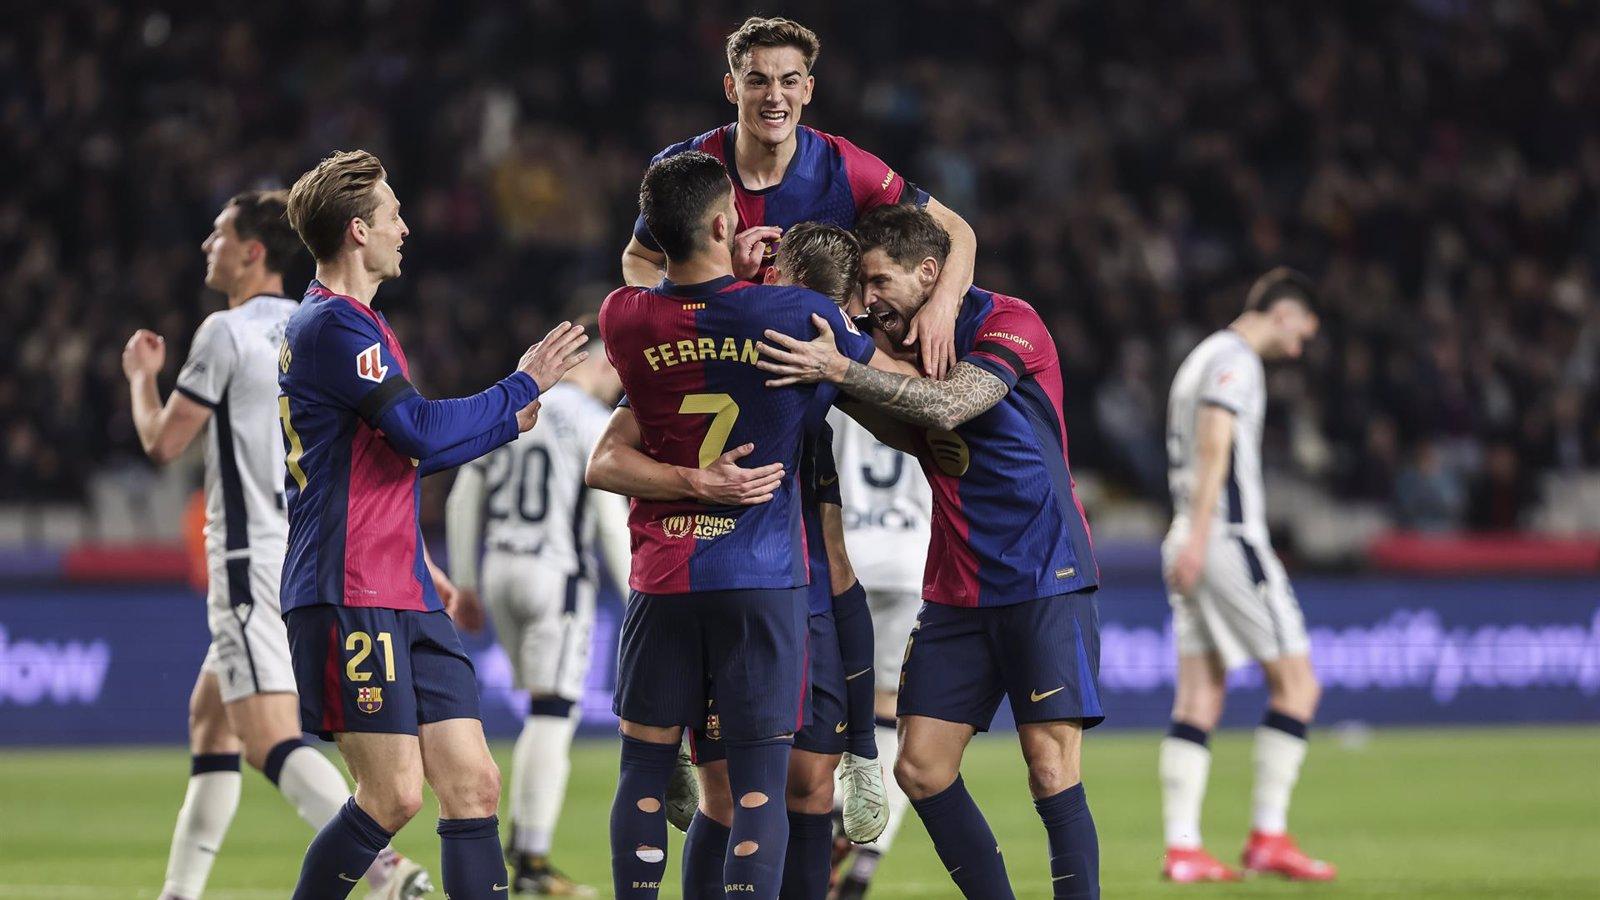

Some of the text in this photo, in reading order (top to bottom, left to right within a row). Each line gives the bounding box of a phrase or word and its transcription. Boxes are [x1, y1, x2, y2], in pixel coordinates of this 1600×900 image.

[278, 338, 293, 374] NG
[643, 337, 760, 372] FERRAN
[983, 332, 1029, 348] AMBILIGHT
[678, 393, 740, 470] 7
[486, 444, 550, 521] 20
[693, 525, 732, 537] ACN
[345, 631, 396, 682] 21
